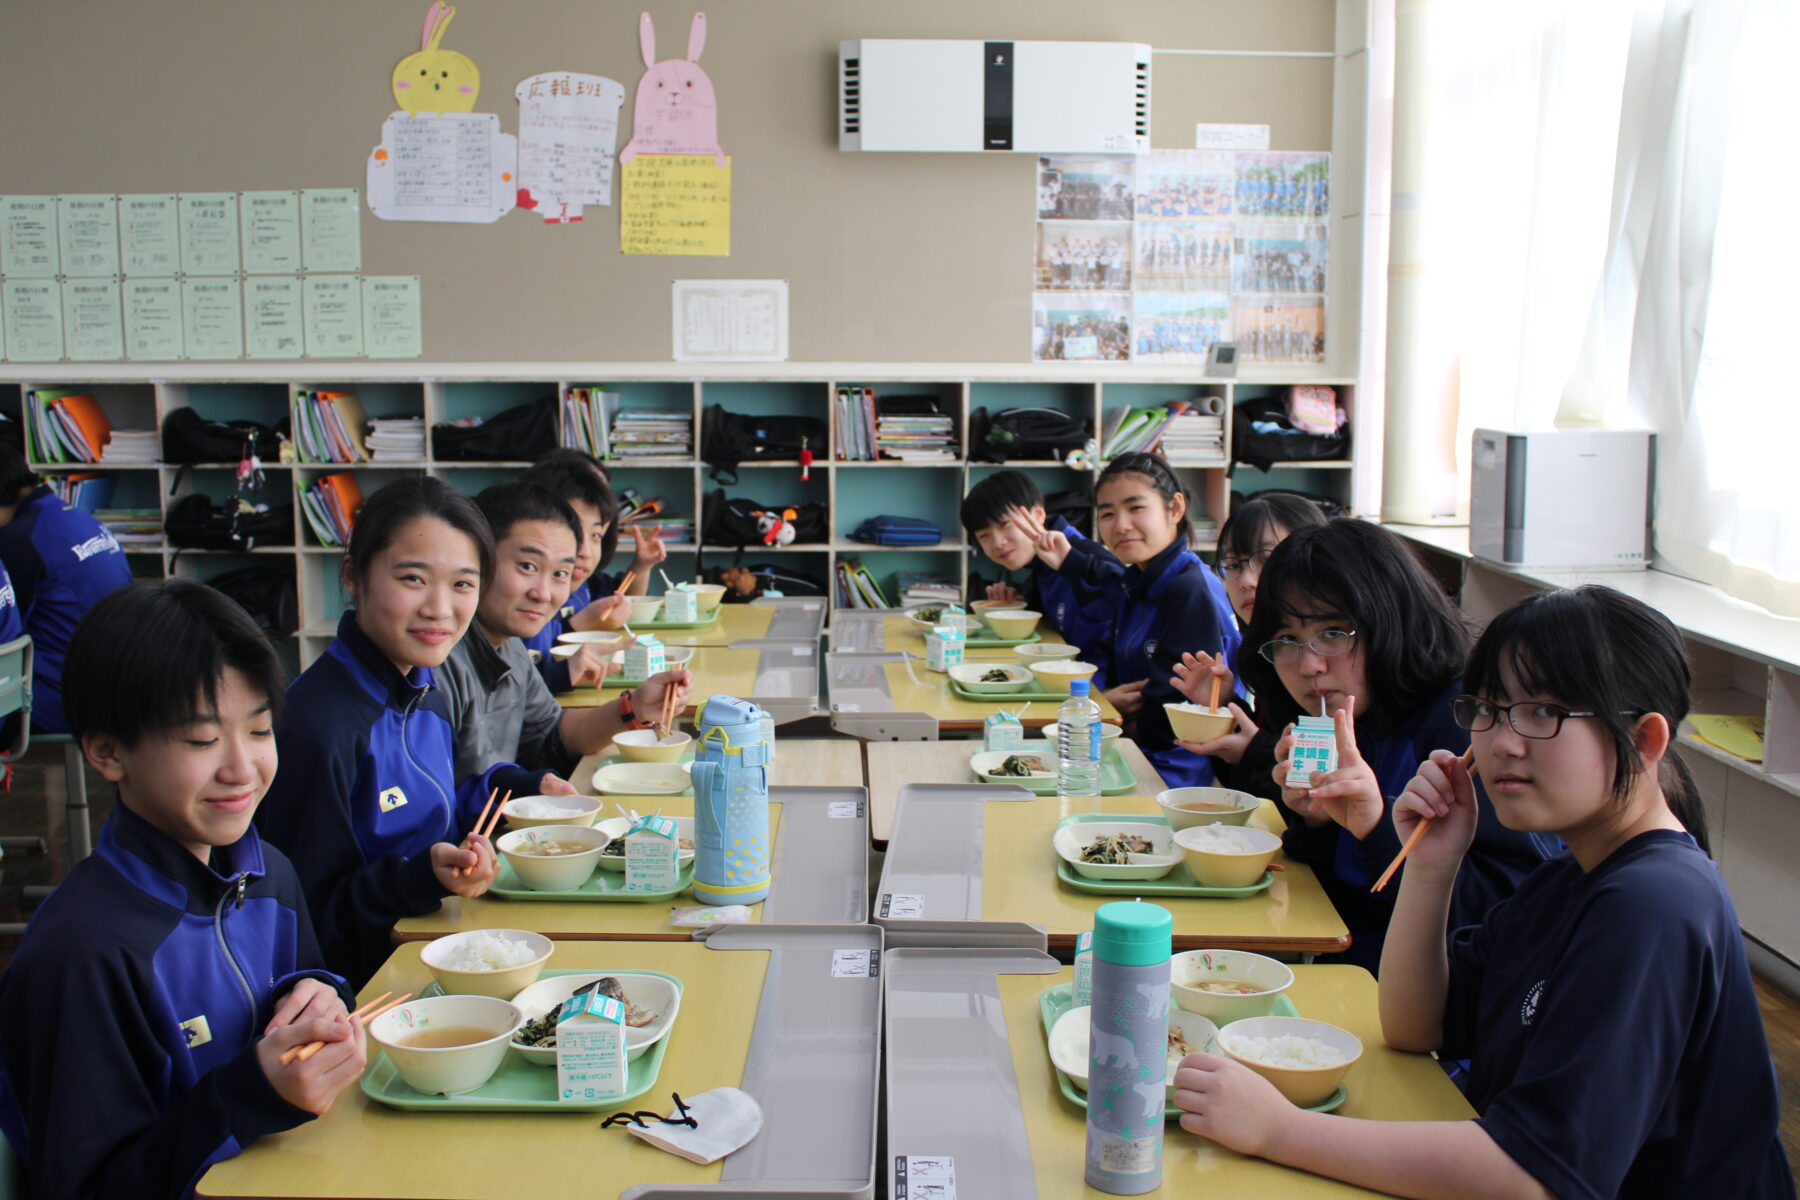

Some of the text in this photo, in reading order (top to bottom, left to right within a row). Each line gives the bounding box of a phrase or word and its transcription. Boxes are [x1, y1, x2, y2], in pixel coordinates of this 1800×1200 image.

[527, 77, 603, 100] 広報班
[1294, 747, 1330, 760] 無調整
[1293, 760, 1328, 773] 牛乳
